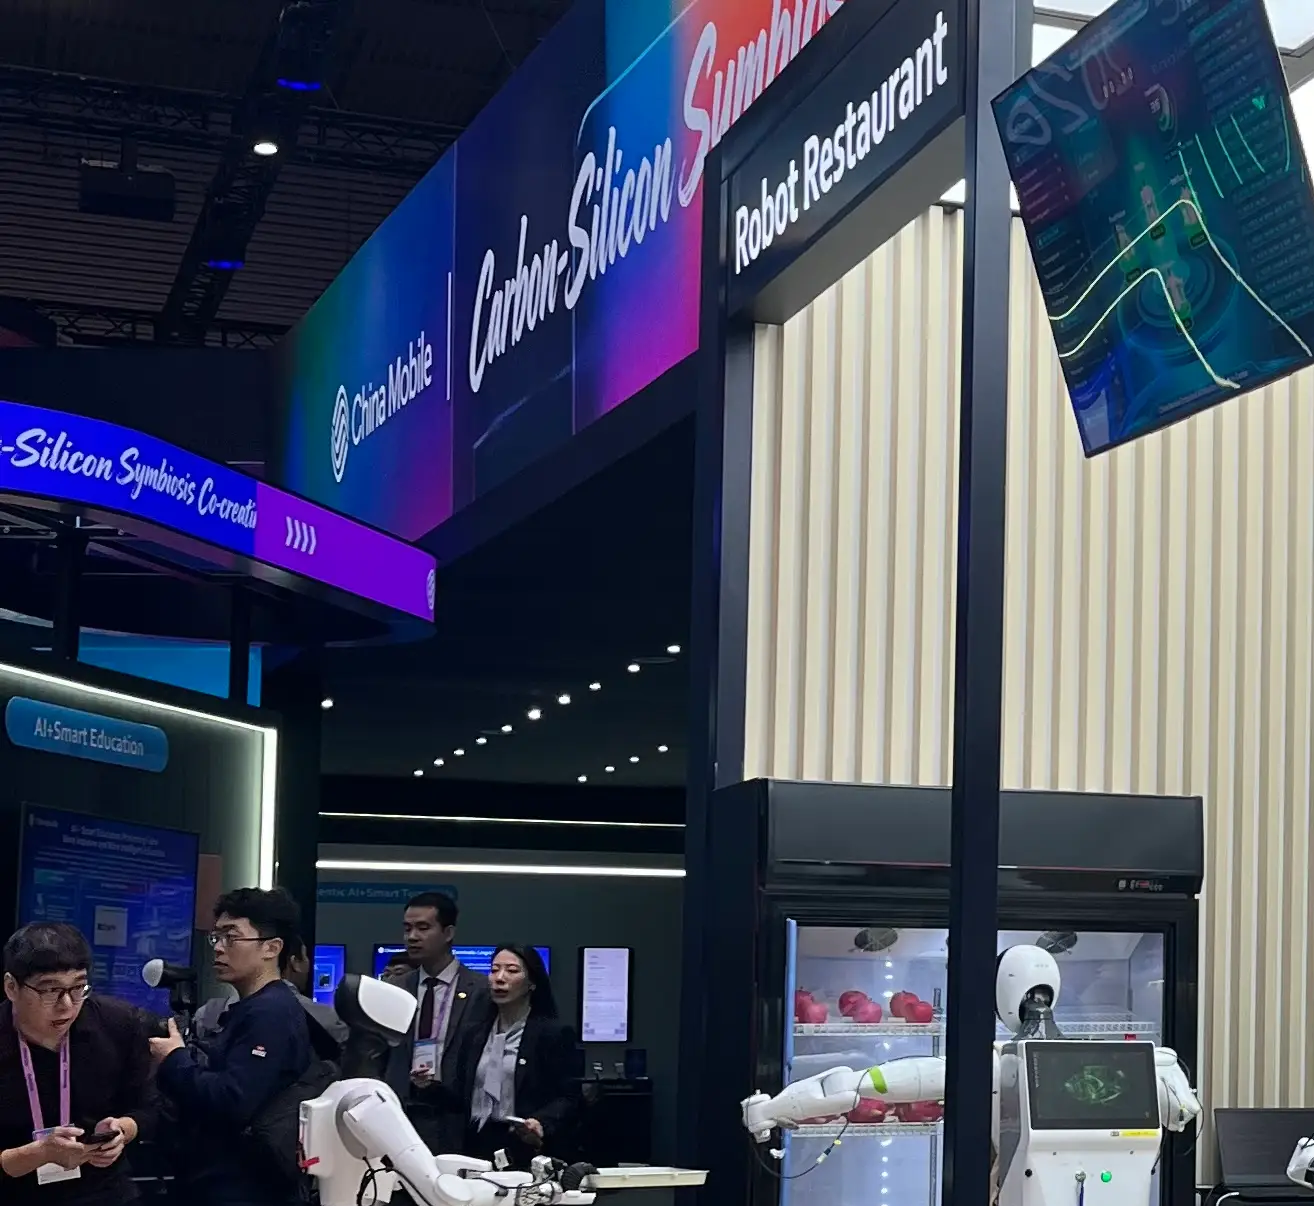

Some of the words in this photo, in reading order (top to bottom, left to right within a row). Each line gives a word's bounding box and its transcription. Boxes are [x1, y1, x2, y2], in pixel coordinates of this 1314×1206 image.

[735, 159, 799, 275] Robot
[803, 11, 948, 211] Restaurant
[468, 126, 674, 393] Carbon-Silicon
[351, 382, 387, 446] China
[387, 330, 433, 418] Mobile
[0, 428, 113, 481] -Silicon
[115, 447, 196, 505] Symbiosis
[33, 716, 88, 746] AI+Smart
[89, 728, 145, 756] Education
